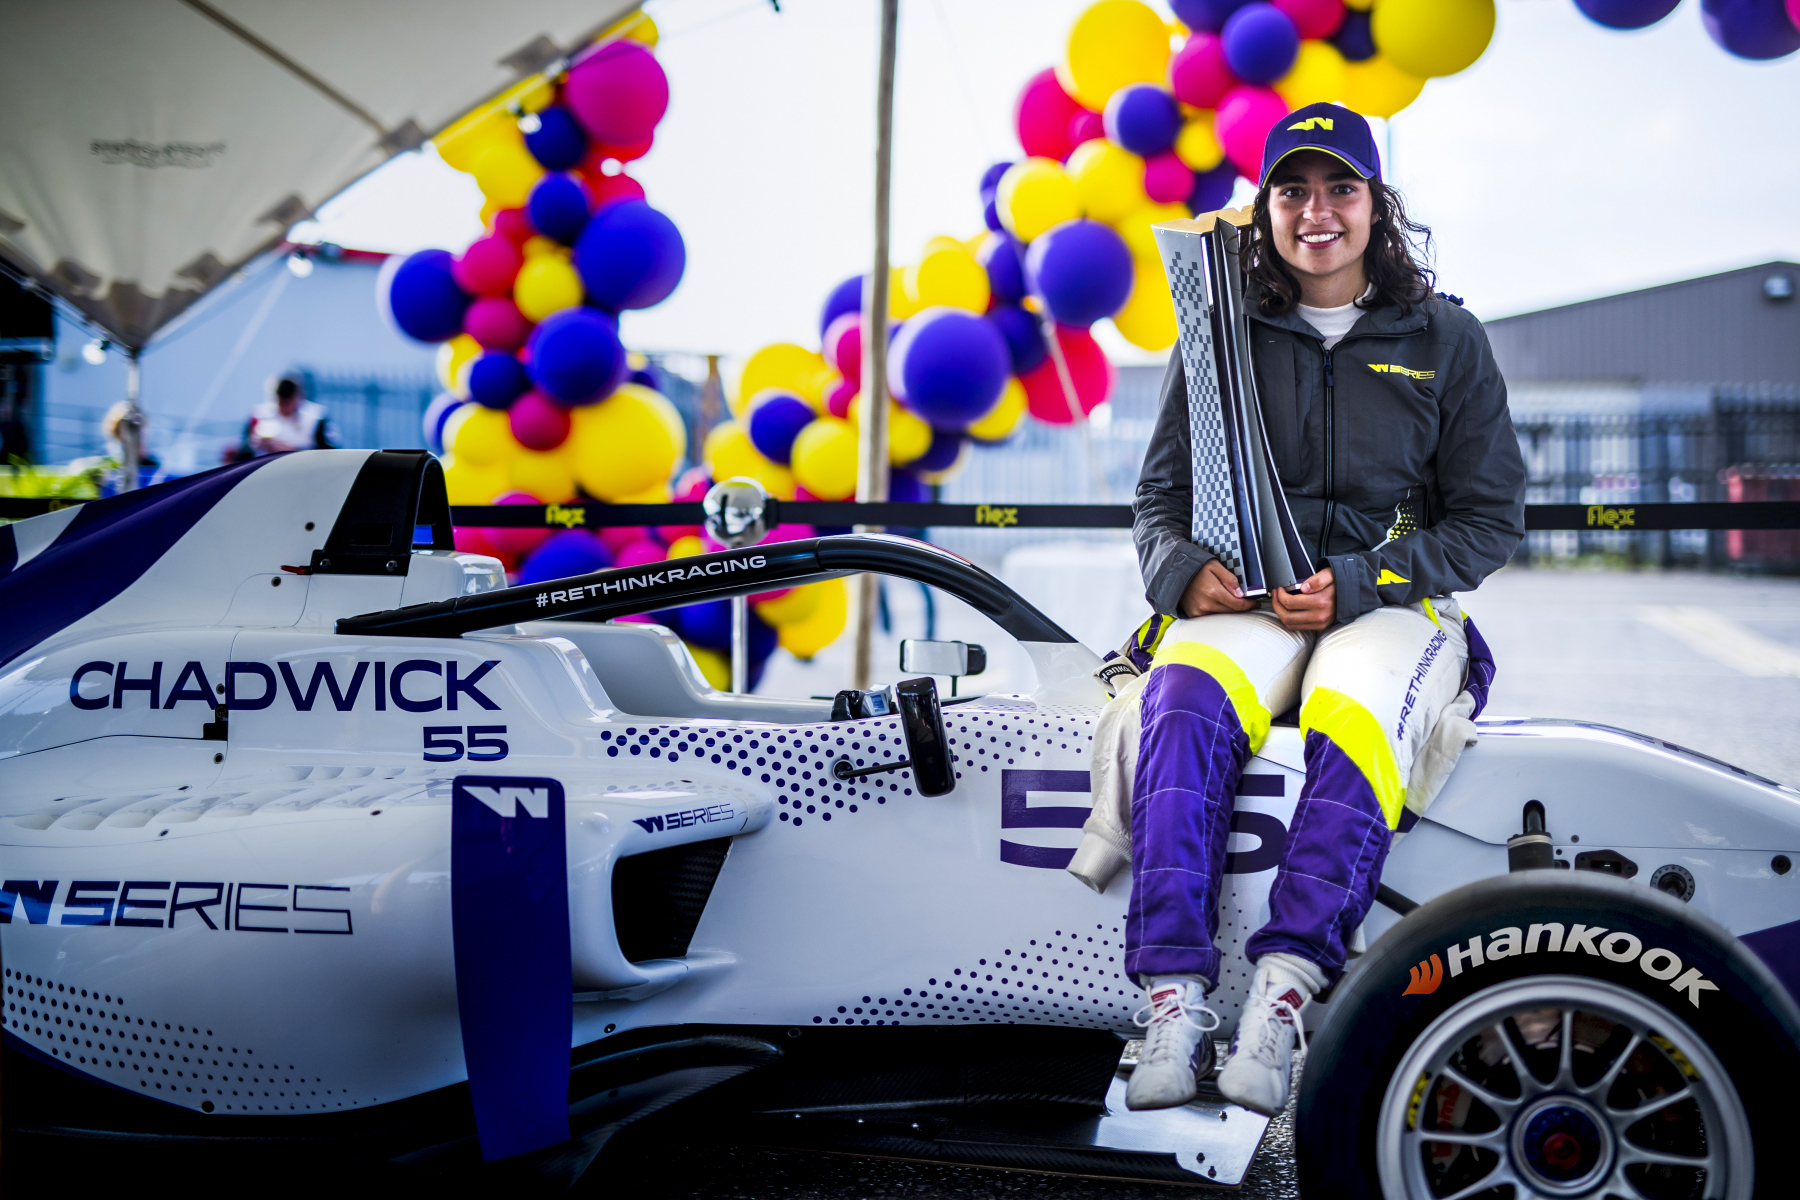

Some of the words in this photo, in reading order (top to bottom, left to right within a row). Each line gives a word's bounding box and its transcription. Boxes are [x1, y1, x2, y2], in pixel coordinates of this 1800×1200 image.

[545, 503, 586, 528] flex
[976, 504, 1018, 528] flex
[1587, 504, 1635, 530] flex
[535, 554, 768, 608] #RETHINKRACING
[69, 658, 503, 713] CHADWICK
[1101, 665, 1133, 684] Hanko
[1397, 629, 1448, 741] #RETHINKRACING
[422, 724, 509, 763] 55
[666, 803, 735, 831] SERIES
[60, 880, 353, 935] SERIES
